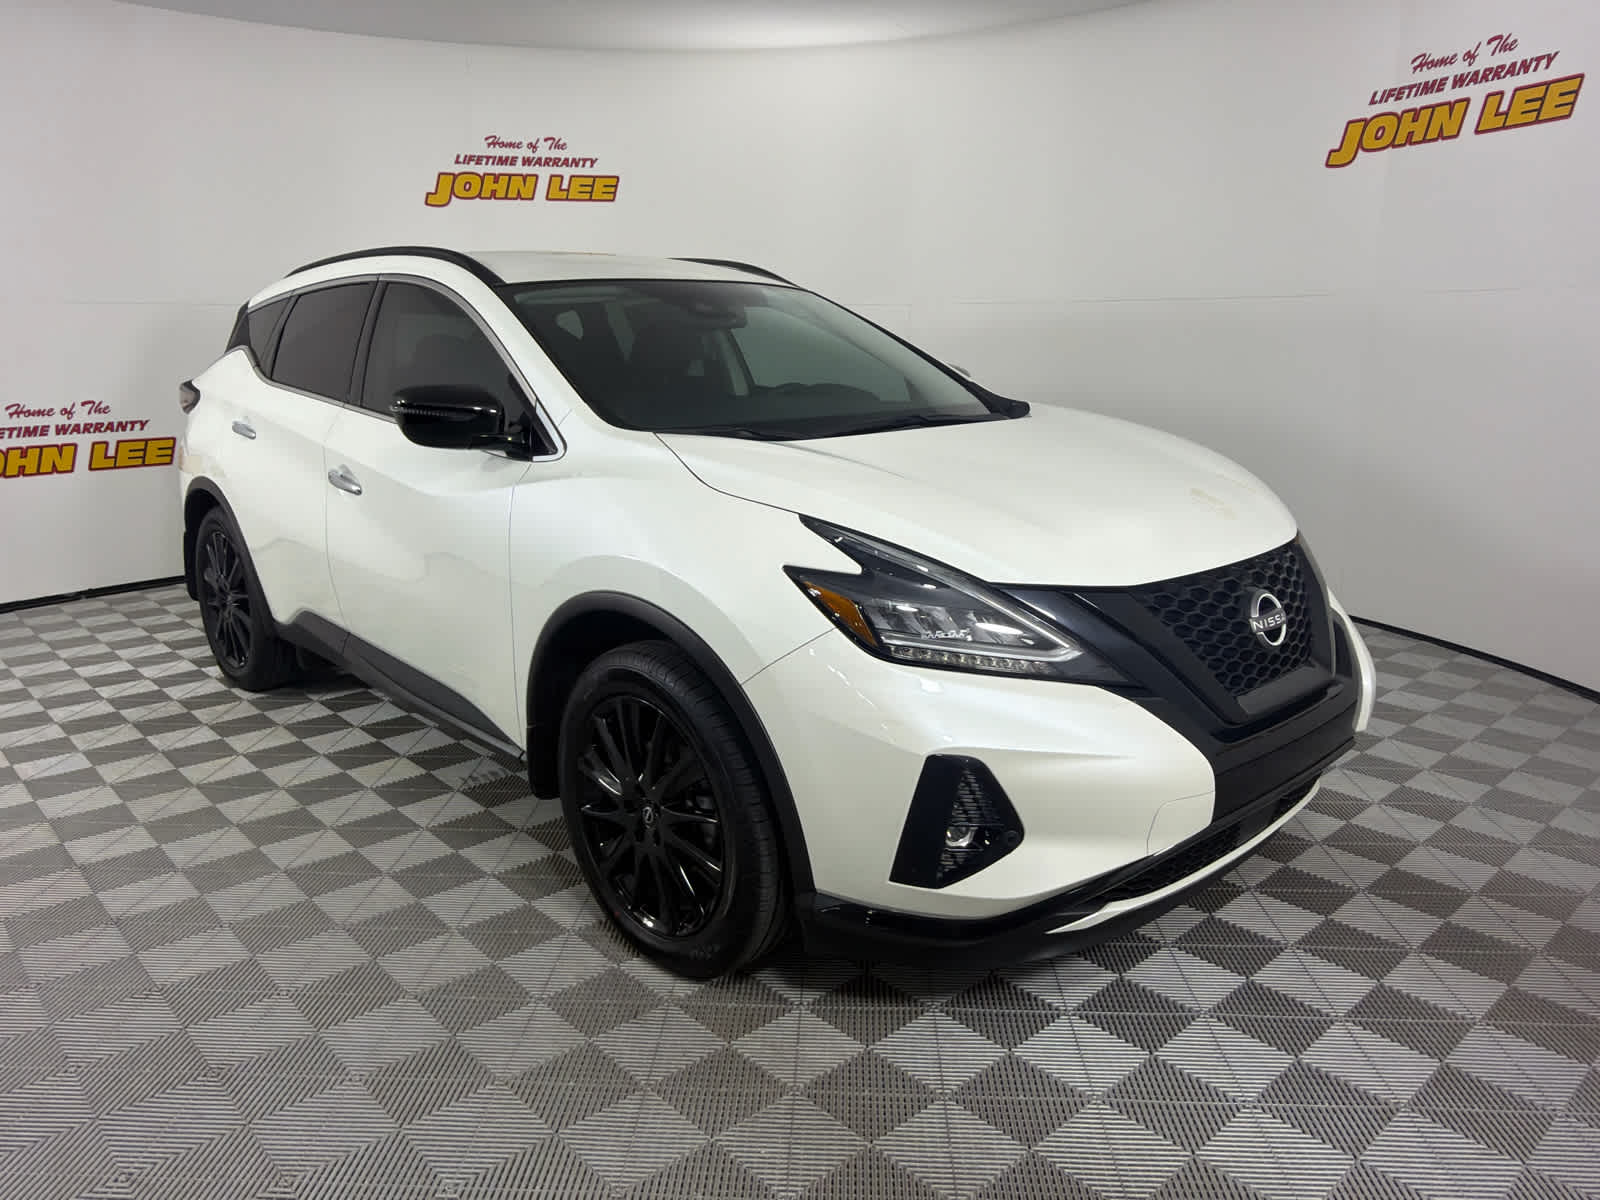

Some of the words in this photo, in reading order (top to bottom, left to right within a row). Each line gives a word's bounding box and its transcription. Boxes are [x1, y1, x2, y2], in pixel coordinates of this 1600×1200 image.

[1410, 53, 1457, 74] Home
[1462, 41, 1482, 66] of
[1486, 32, 1518, 56] The
[1368, 76, 1448, 105] LIFETIME
[1450, 50, 1560, 90] WARRANTY
[1325, 97, 1471, 168] JOHN
[1474, 73, 1585, 135] LEE
[454, 154, 518, 167] LIFETIME
[521, 155, 598, 168] WARRANTY
[484, 135, 523, 150] Home
[526, 138, 540, 153] of
[543, 136, 567, 150] The
[424, 171, 539, 208] JOHN
[545, 174, 620, 202] LEE
[5, 403, 56, 419] Home
[60, 402, 76, 420] of
[81, 400, 111, 415] The
[55, 419, 149, 436] WARRANTY
[88, 436, 177, 472] LEE
